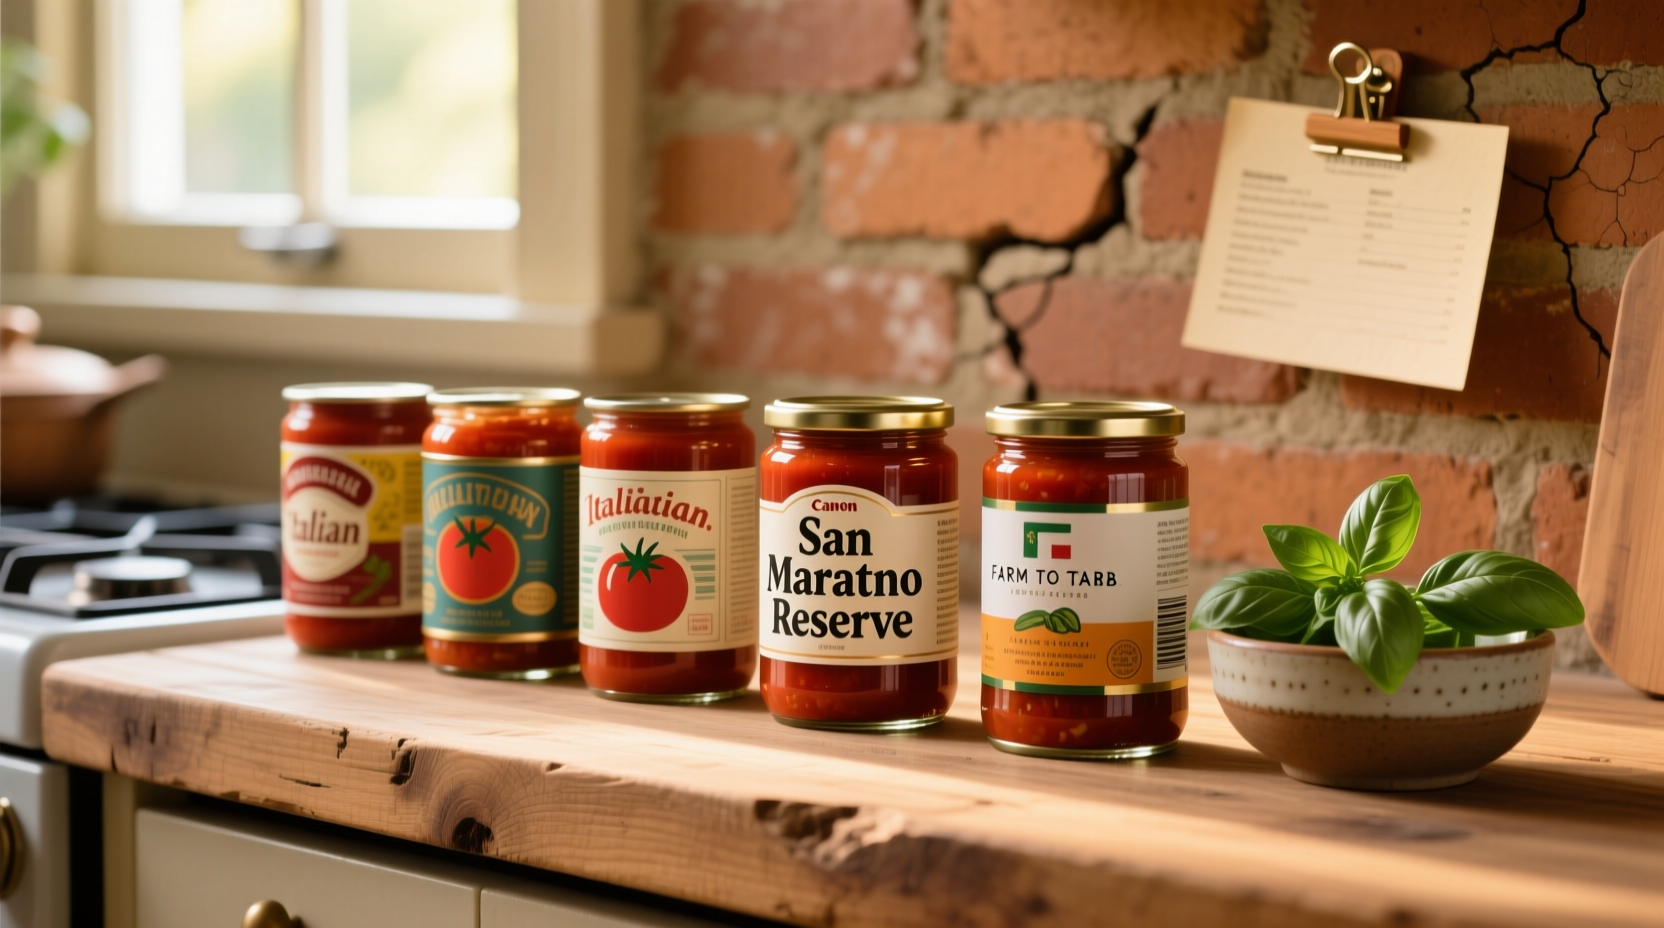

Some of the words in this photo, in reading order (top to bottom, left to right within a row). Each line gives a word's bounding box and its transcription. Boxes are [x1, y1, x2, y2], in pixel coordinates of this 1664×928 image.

[811, 499, 858, 512] Canon
[798, 516, 873, 556] San
[767, 554, 923, 597] Maratno
[991, 564, 1028, 584] FARM
[1036, 569, 1060, 586] TO
[772, 598, 913, 639] Reserve
